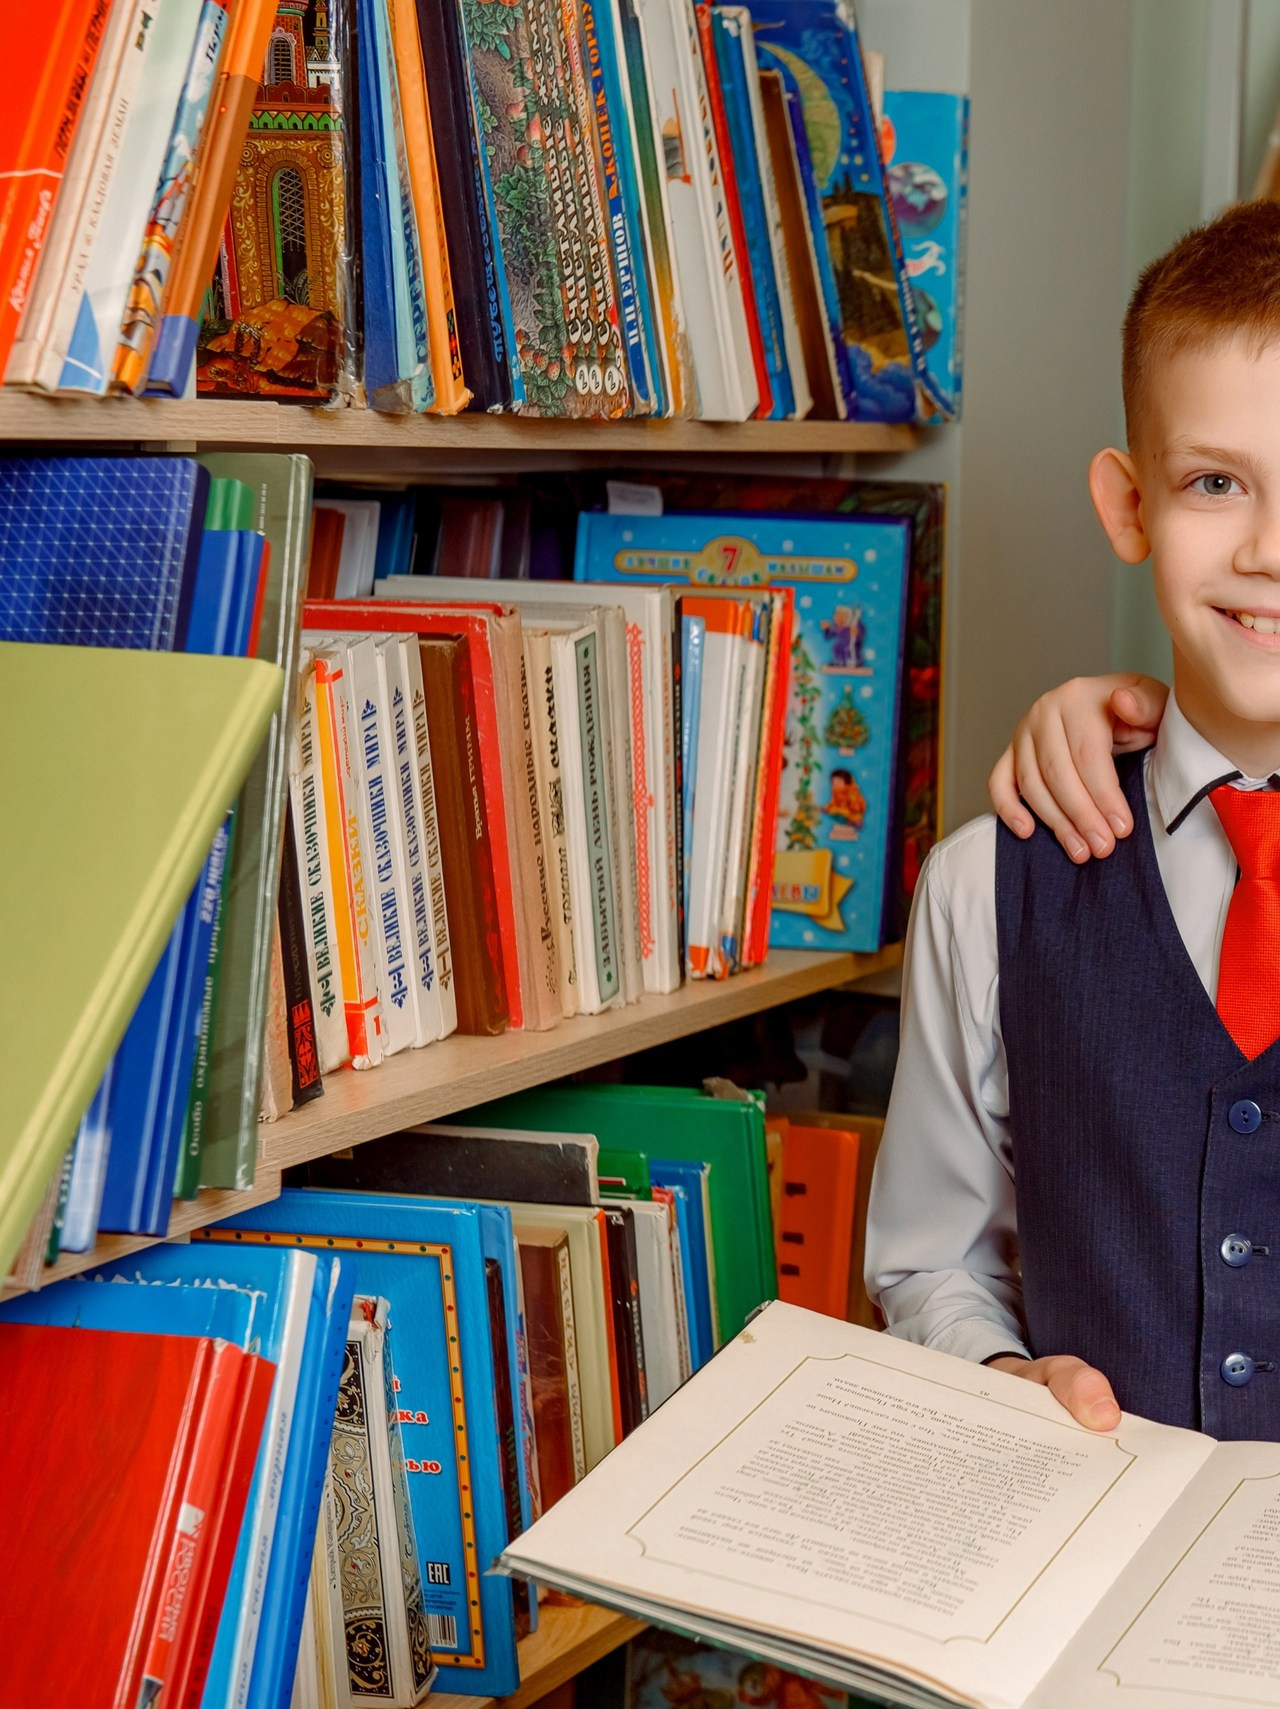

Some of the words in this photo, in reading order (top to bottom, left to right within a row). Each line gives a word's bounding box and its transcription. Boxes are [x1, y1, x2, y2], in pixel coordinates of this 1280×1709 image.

[721, 545, 739, 573] 7
[298, 720, 314, 765] МИРА
[361, 721, 381, 769] МИРА
[393, 708, 408, 754] МИРА
[413, 711, 429, 756] МИРА
[459, 714, 480, 782] ГРИММ
[580, 661, 599, 784] РОЖДЕНИЯ
[367, 774, 393, 882] СКАЗОЧНИКИ
[398, 760, 421, 866] СКАЗОЧНИКИ
[417, 761, 441, 867] СКАЗОЧНИКИ
[467, 785, 484, 839] Братья
[524, 738, 542, 845] народные
[590, 791, 602, 849] ДЕНЬ
[298, 774, 323, 886] СКАЗОЧНИКИ
[346, 815, 370, 939] СКАЗКИ
[410, 872, 430, 947] ВЕЛИКИЕ
[428, 873, 448, 946] ВЕЛИКИЕ
[532, 854, 552, 944] Русские
[594, 856, 611, 967] ЗАБЫТЫЙ
[309, 891, 330, 970] ВЕЛИКИЕ
[379, 887, 402, 964] ВЕЛИКИЕ
[190, 975, 219, 1087] охраняемые
[186, 1099, 206, 1156] Особо
[427, 1562, 450, 1585] EAC
